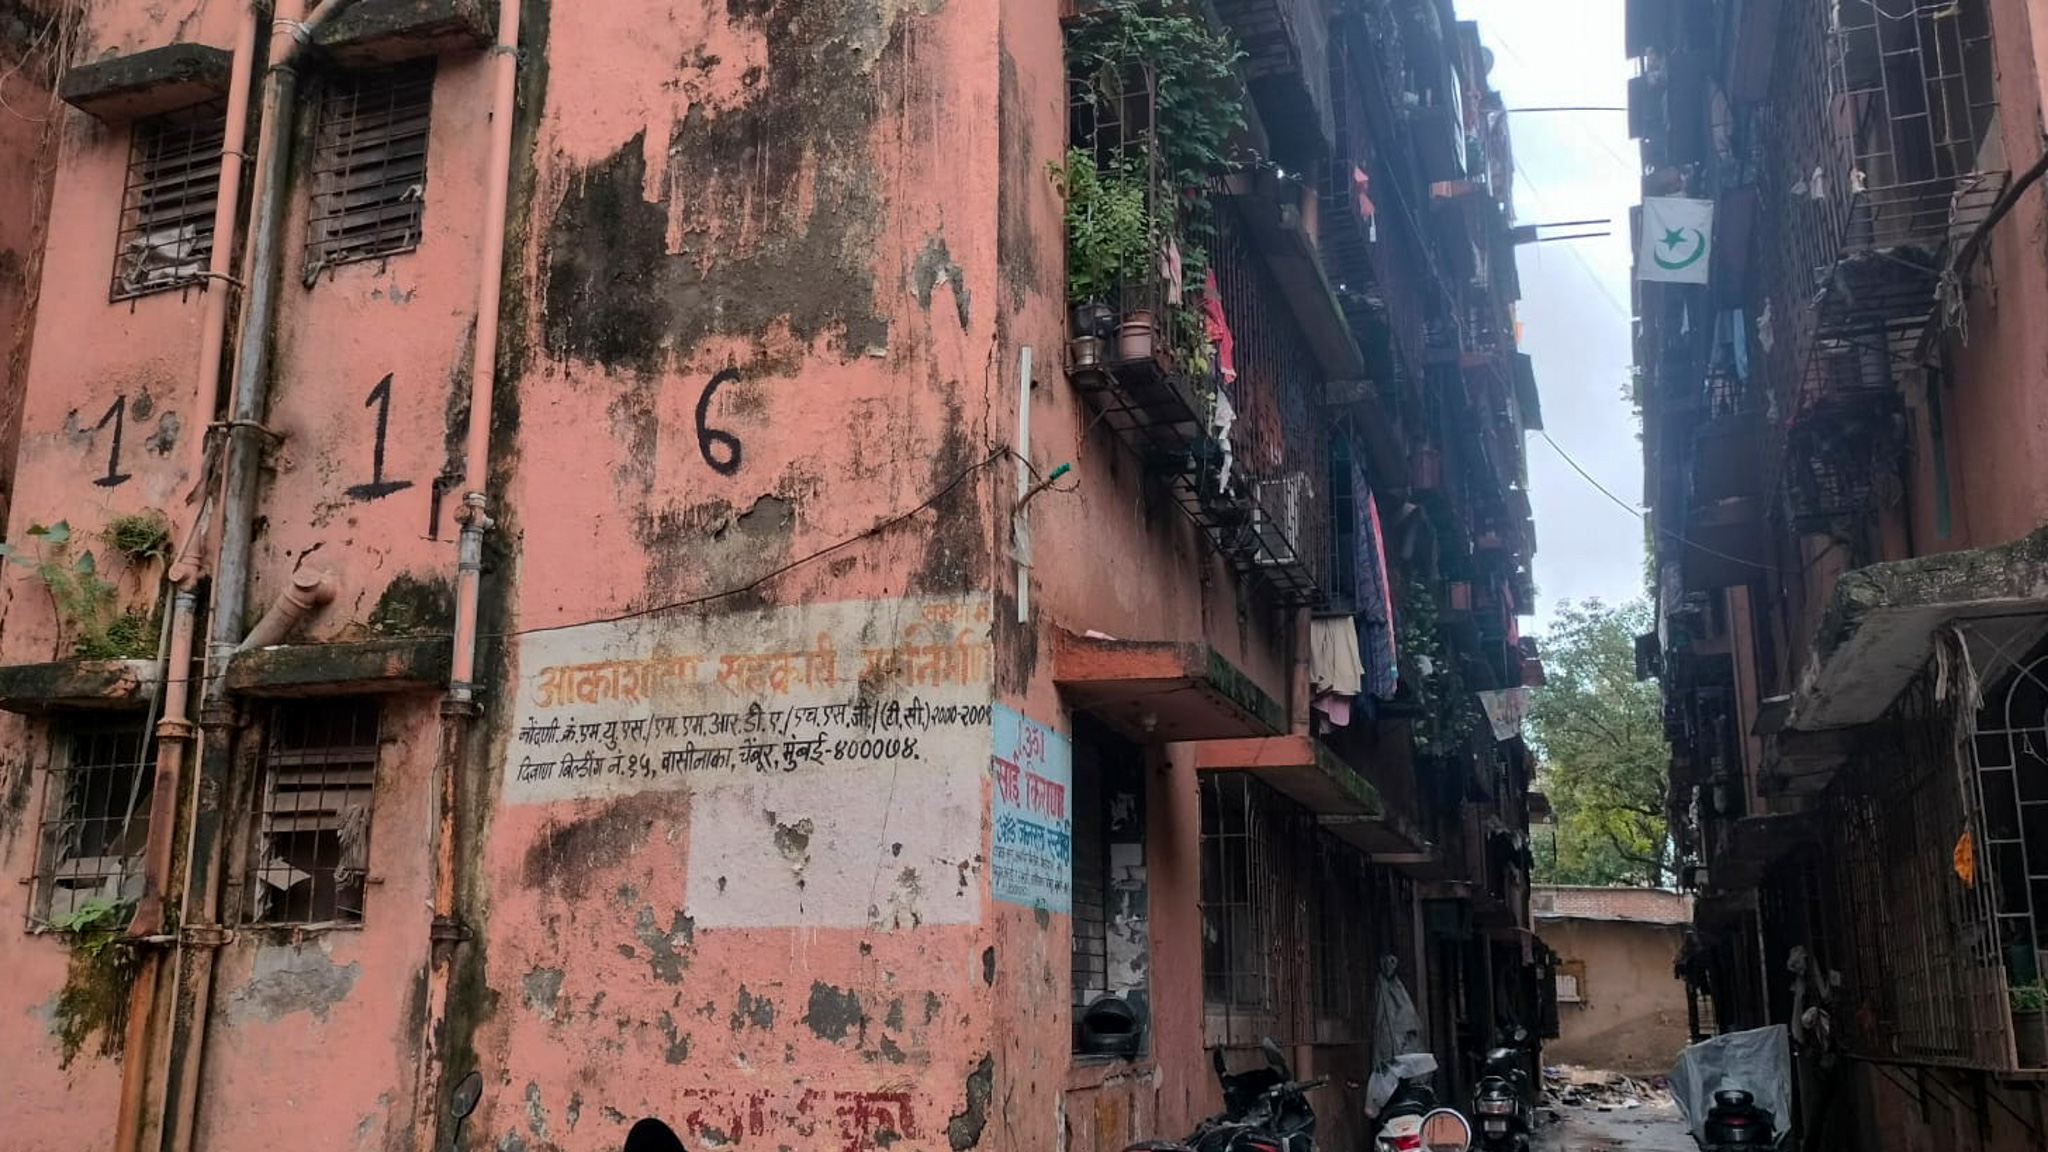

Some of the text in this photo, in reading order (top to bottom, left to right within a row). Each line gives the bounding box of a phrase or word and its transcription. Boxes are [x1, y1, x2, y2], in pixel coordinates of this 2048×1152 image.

[93, 366, 742, 501] 1 1 6
